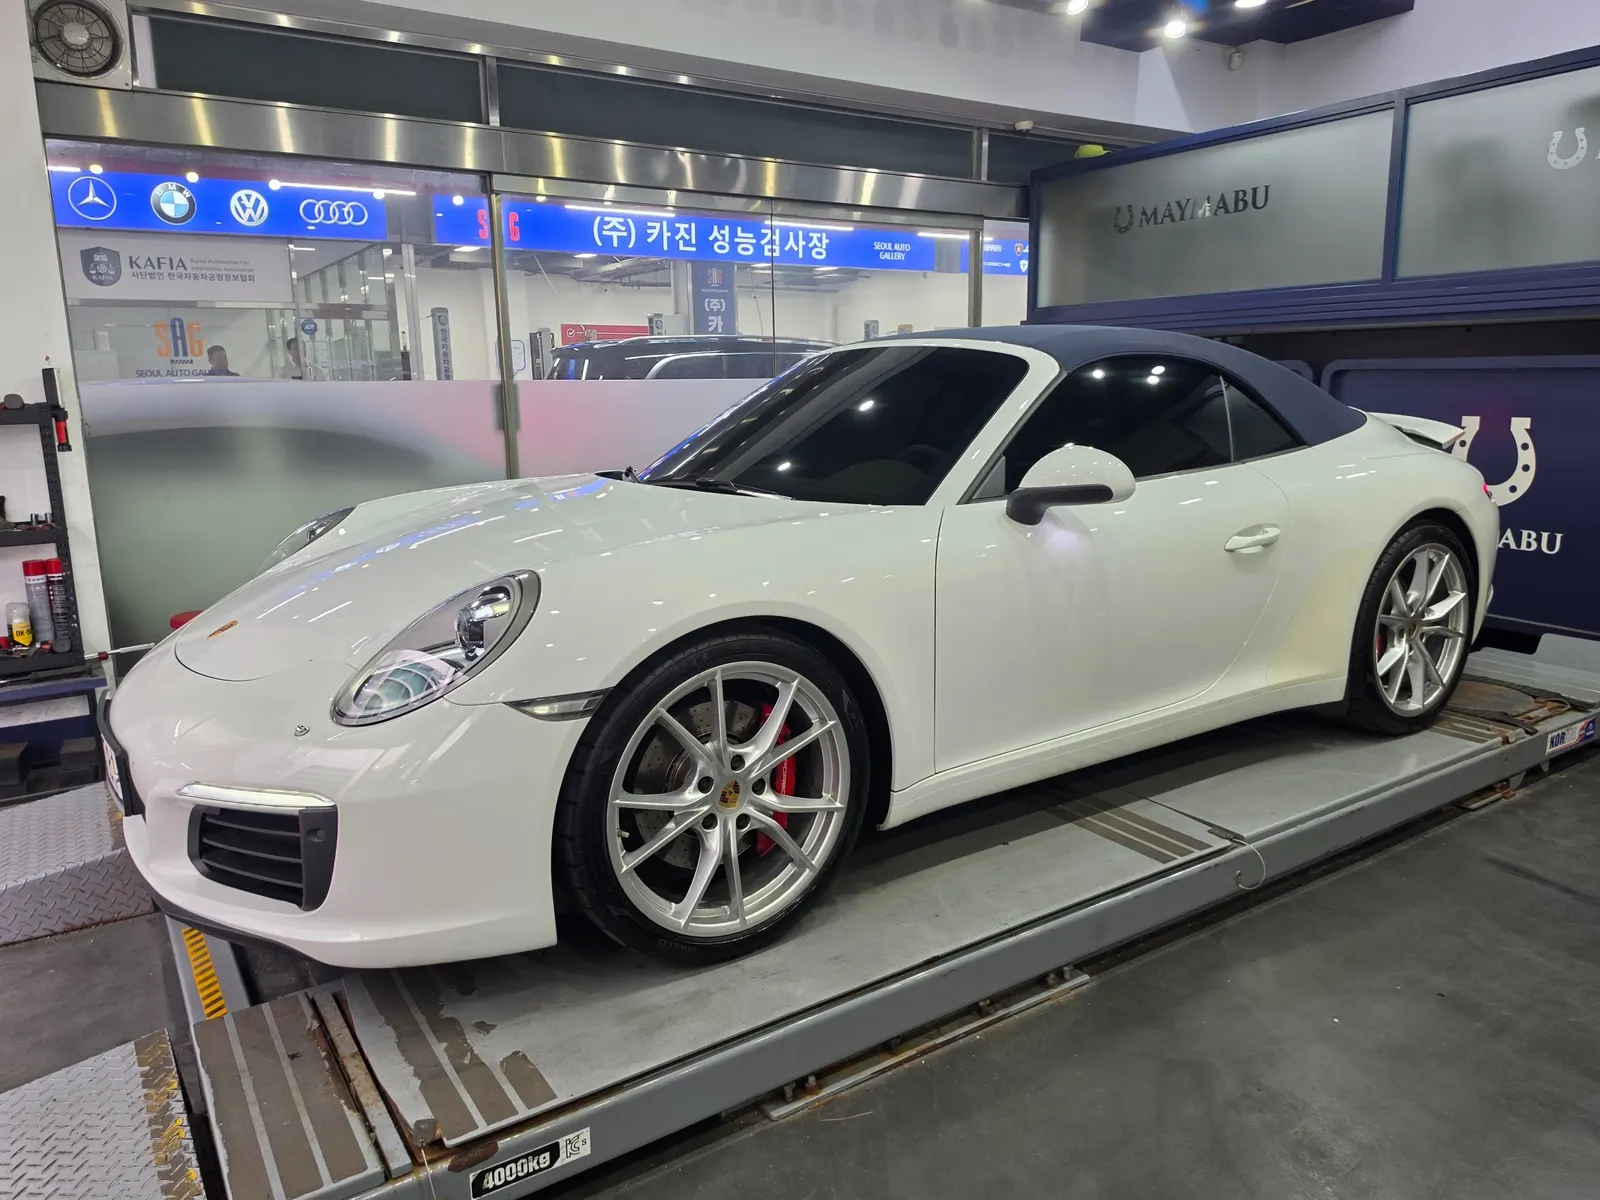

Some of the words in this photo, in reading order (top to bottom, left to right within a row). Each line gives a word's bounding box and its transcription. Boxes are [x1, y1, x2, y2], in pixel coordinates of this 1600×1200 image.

[155, 183, 192, 198] BMW
[592, 215, 637, 248] (주)
[646, 220, 697, 252] 카진
[708, 224, 829, 260] 성능검사장
[873, 241, 893, 251] SEOUL
[893, 242, 911, 252] AUTO
[128, 255, 188, 271] KAFIA
[879, 251, 906, 261] GALLERY
[131, 271, 165, 281] 사단법인
[704, 298, 726, 312] (주)
[708, 315, 724, 333] 카
[153, 317, 204, 358] SAG
[135, 369, 164, 378] SEOUL
[165, 369, 191, 377] AUTO
[482, 1151, 551, 1189] 4000kg
